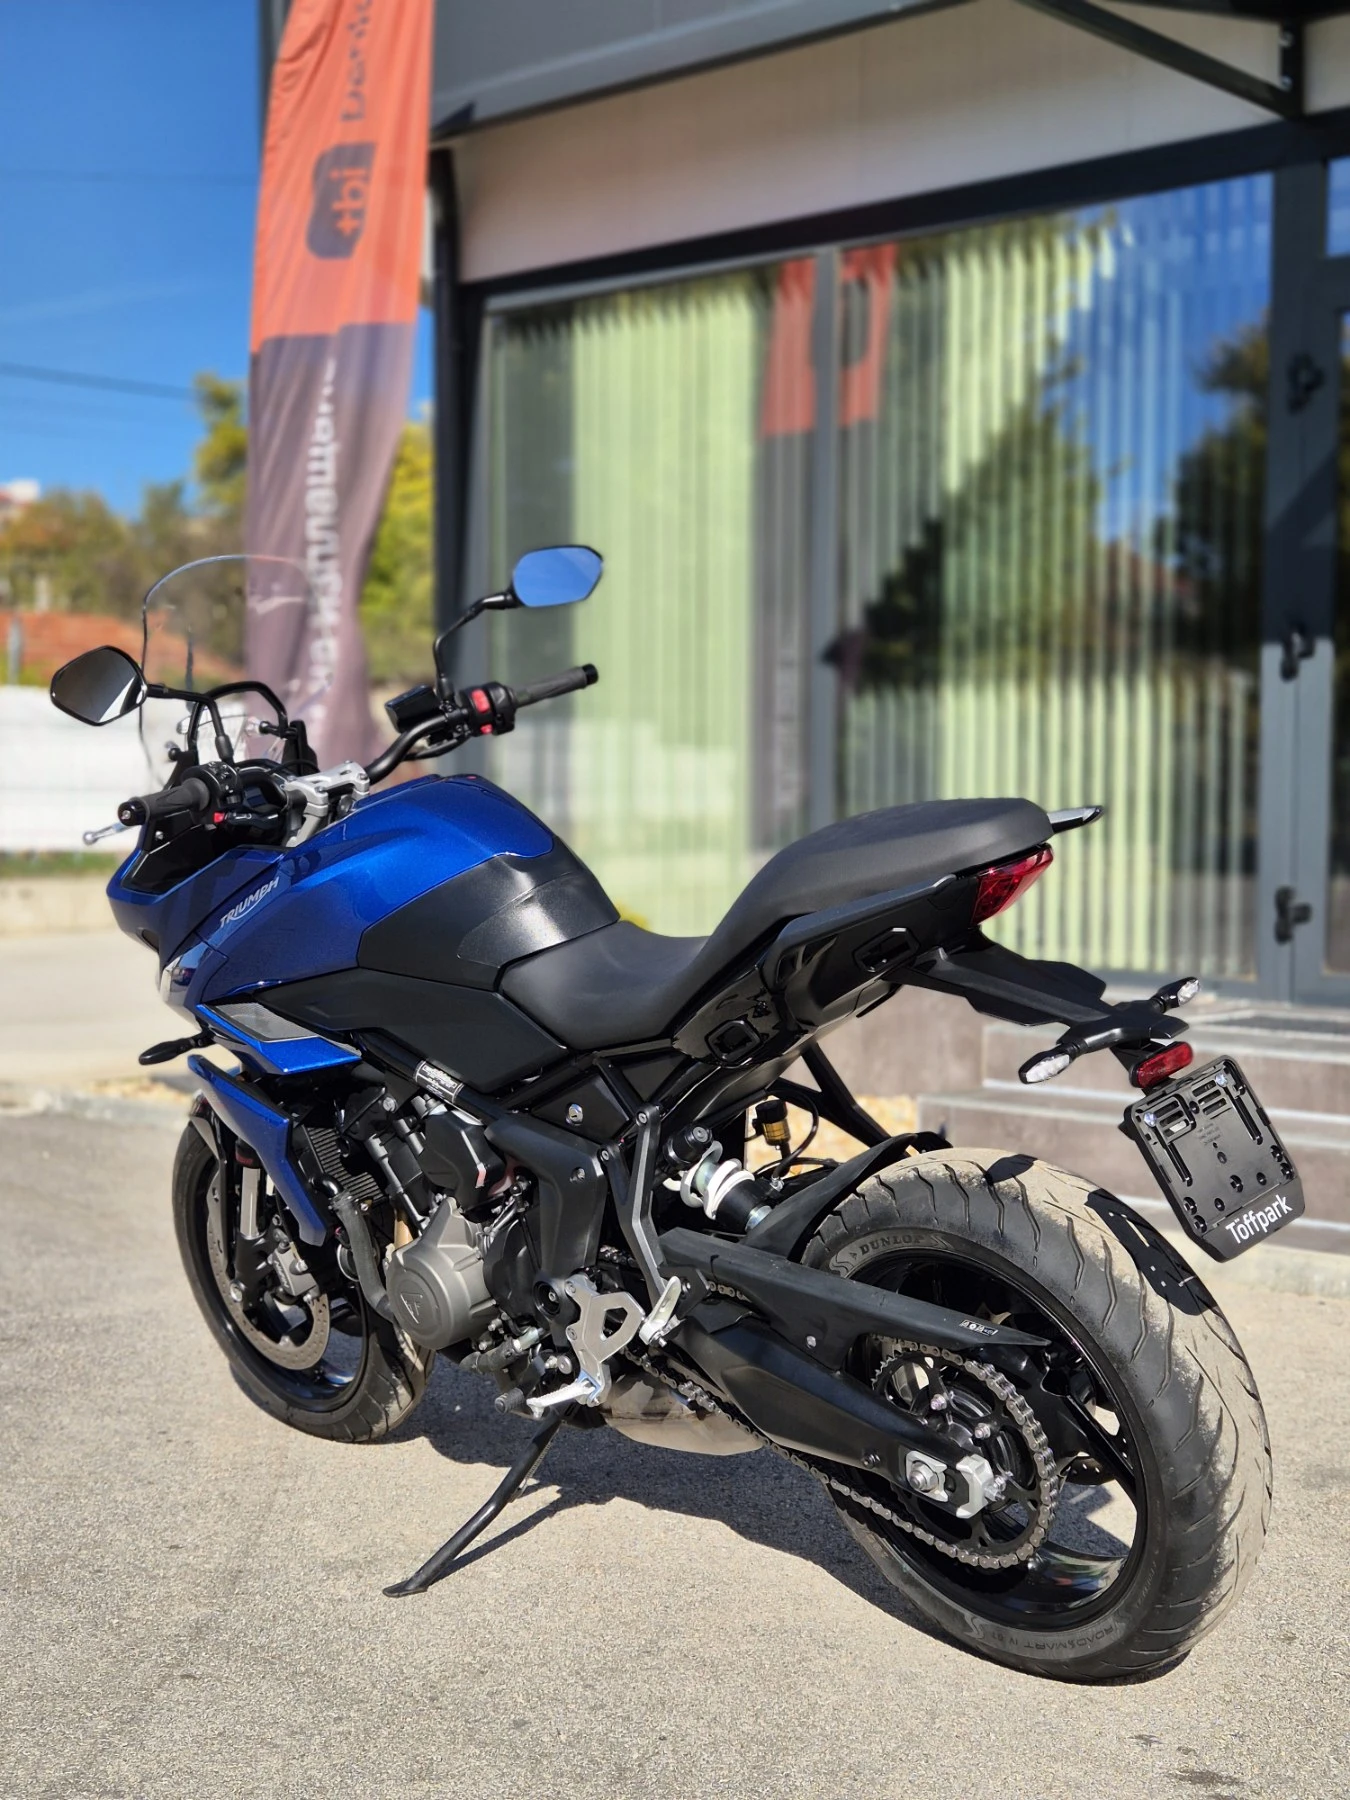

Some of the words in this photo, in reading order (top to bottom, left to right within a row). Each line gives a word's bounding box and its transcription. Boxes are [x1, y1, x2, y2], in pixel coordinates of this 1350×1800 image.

[220, 876, 280, 928] TRIUMPH
[1225, 1194, 1293, 1244] Töffpark
[859, 1233, 924, 1256] DUNLOP
[1024, 1625, 1115, 1649] ROADSMART
